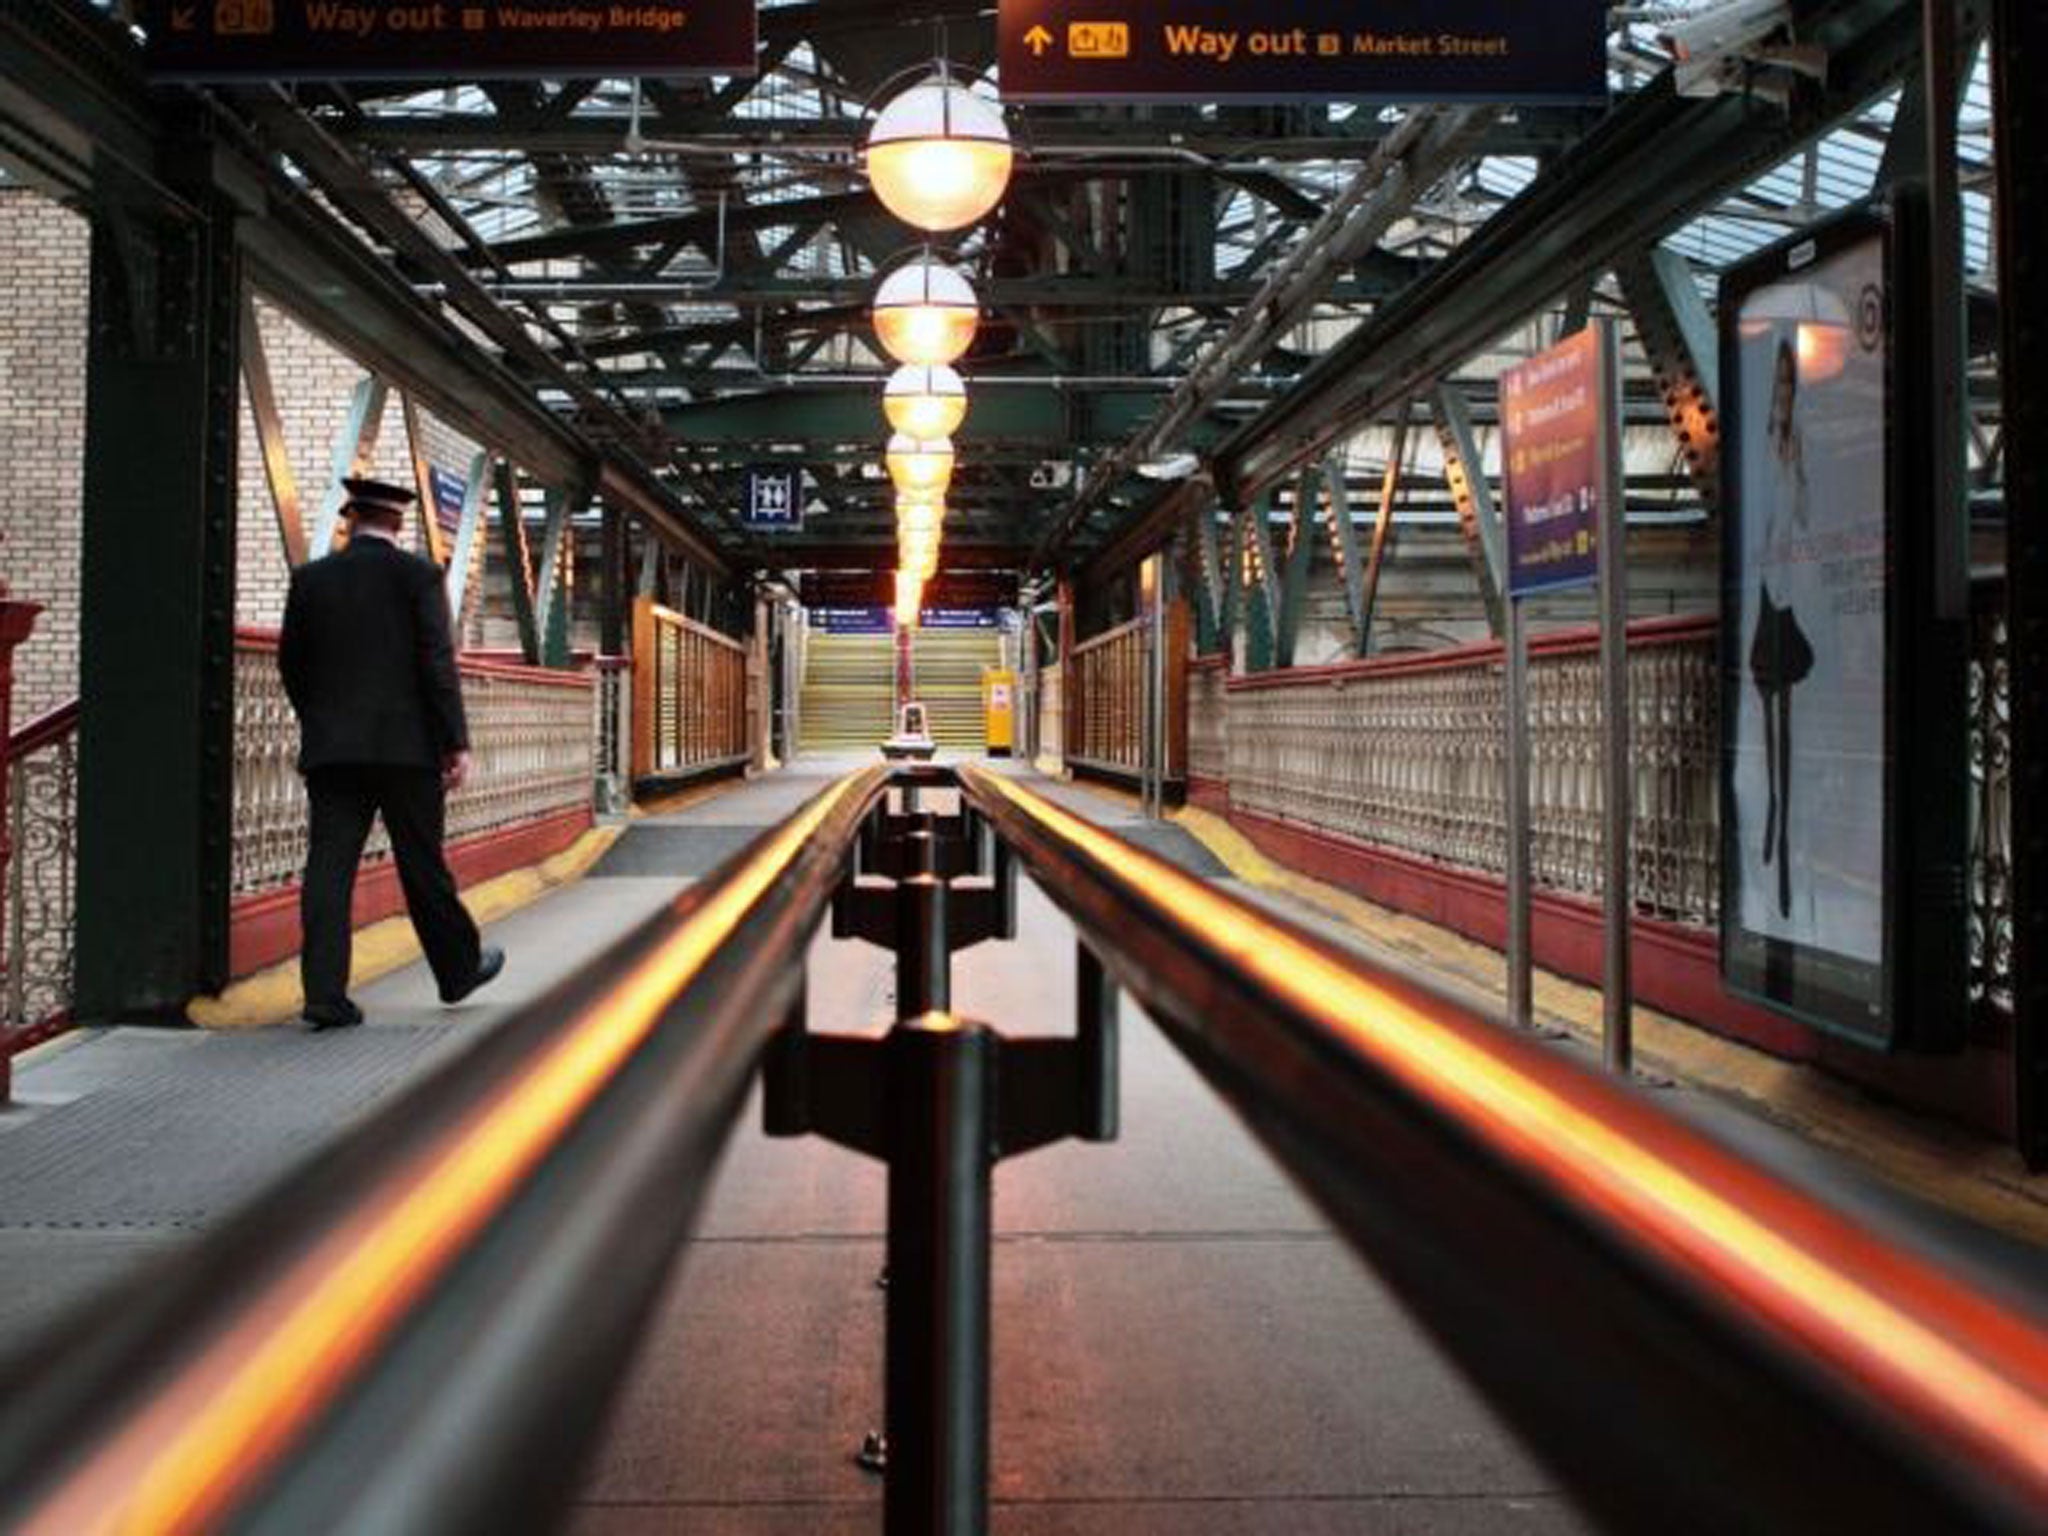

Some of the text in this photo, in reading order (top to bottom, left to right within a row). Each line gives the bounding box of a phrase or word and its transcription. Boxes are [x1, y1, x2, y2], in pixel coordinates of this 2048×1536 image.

[304, 2, 376, 38] Way
[386, 3, 447, 31] out
[497, 6, 602, 33] Waverley
[608, 4, 686, 33] Bridge
[1164, 24, 1238, 61] Way
[1248, 29, 1307, 55] out
[1352, 34, 1430, 56] Market
[1439, 34, 1509, 56] Street
